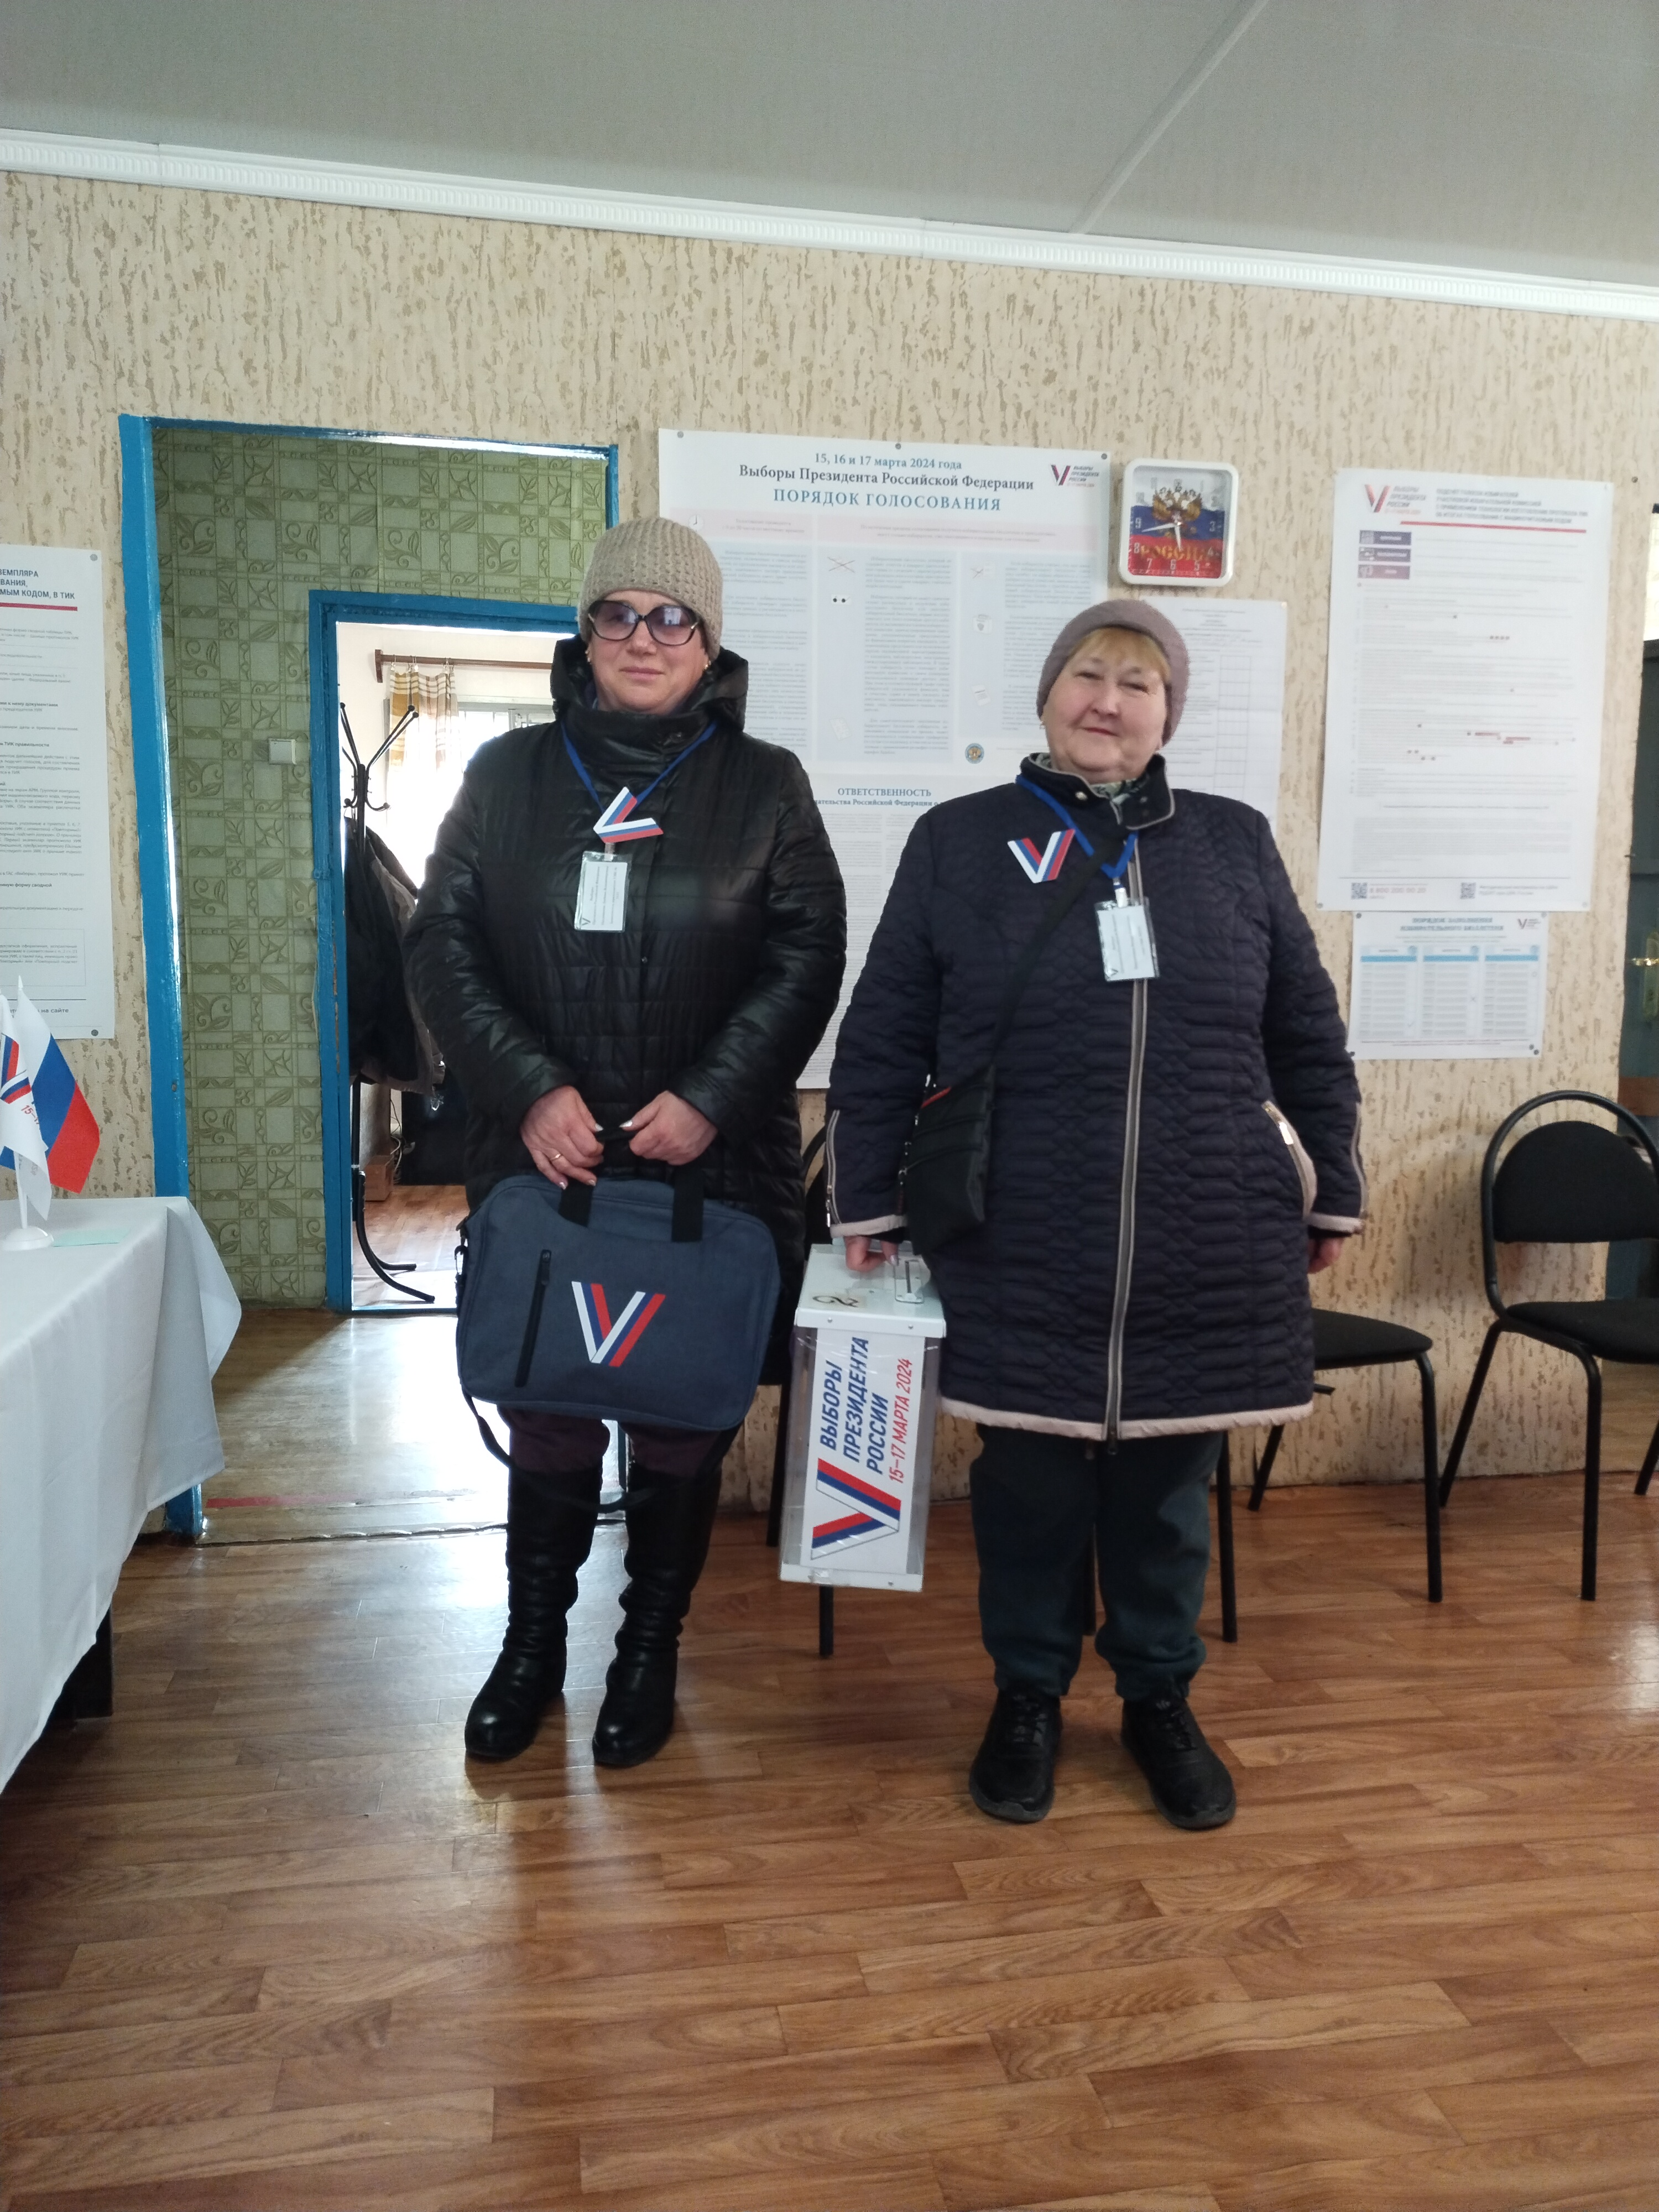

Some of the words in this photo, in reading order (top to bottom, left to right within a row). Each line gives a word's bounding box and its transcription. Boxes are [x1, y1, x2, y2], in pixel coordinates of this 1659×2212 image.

[815, 453, 830, 465] 15,
[834, 454, 846, 465] 16
[860, 456, 871, 466] 17
[874, 458, 906, 469] марта
[910, 458, 935, 468] 2024
[938, 461, 962, 470] года
[739, 465, 795, 482] Выборы
[800, 468, 878, 483] Президента
[882, 472, 958, 486] Российской
[962, 475, 1034, 491] Федерации
[774, 489, 859, 507] ПОРЯДОК
[867, 493, 1000, 511] ГОЛОСОВАНИЯ
[1209, 521, 1215, 531] 3
[22, 590, 51, 599] КОДОМ,
[838, 788, 931, 797] ОТВЕТСТВЕННОСТЬ
[897, 1359, 912, 1394] 2024
[820, 1361, 842, 1451] ВЫБОРЫ
[843, 1337, 869, 1463] ПРЕЗИДЕНТА
[893, 1395, 910, 1443] МАРТА
[867, 1394, 889, 1475] РОССИИ
